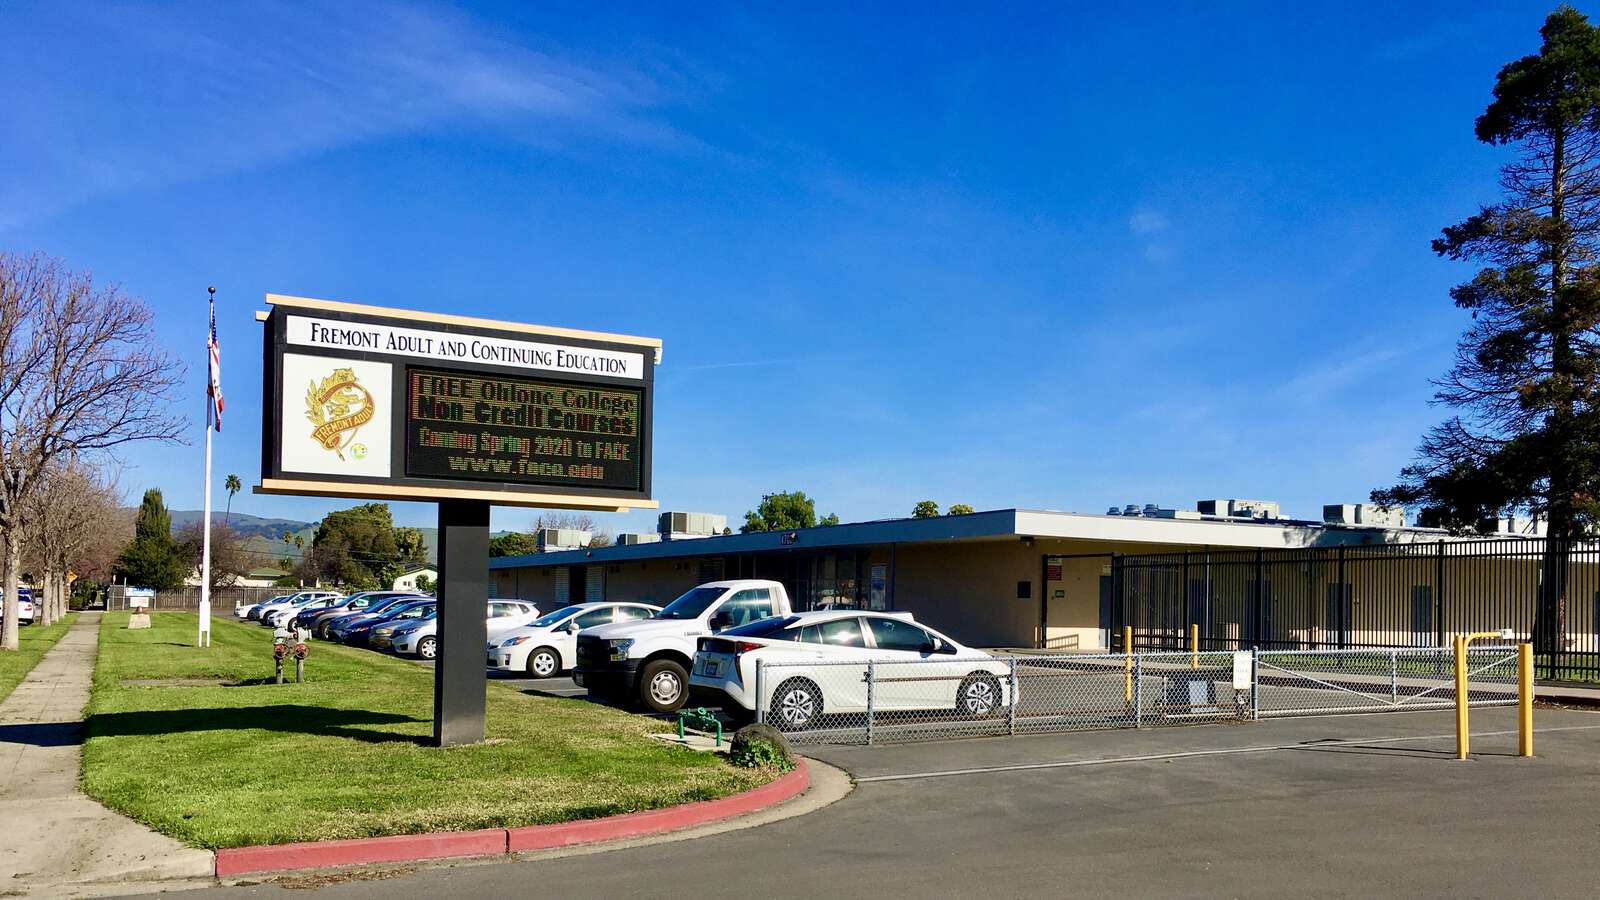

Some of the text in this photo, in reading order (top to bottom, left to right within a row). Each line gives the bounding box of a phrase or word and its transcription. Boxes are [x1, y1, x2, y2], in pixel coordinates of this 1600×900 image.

[310, 322, 627, 374] FREMONT ADULT AND CONTINUING EDUCATION
[419, 376, 635, 417] FREE Ohlone College
[315, 418, 354, 440] FREMONT
[548, 408, 633, 434] Courses
[419, 427, 477, 453] Coming
[481, 432, 530, 457] Spring
[535, 436, 573, 457] 2020
[595, 441, 630, 461] FACE
